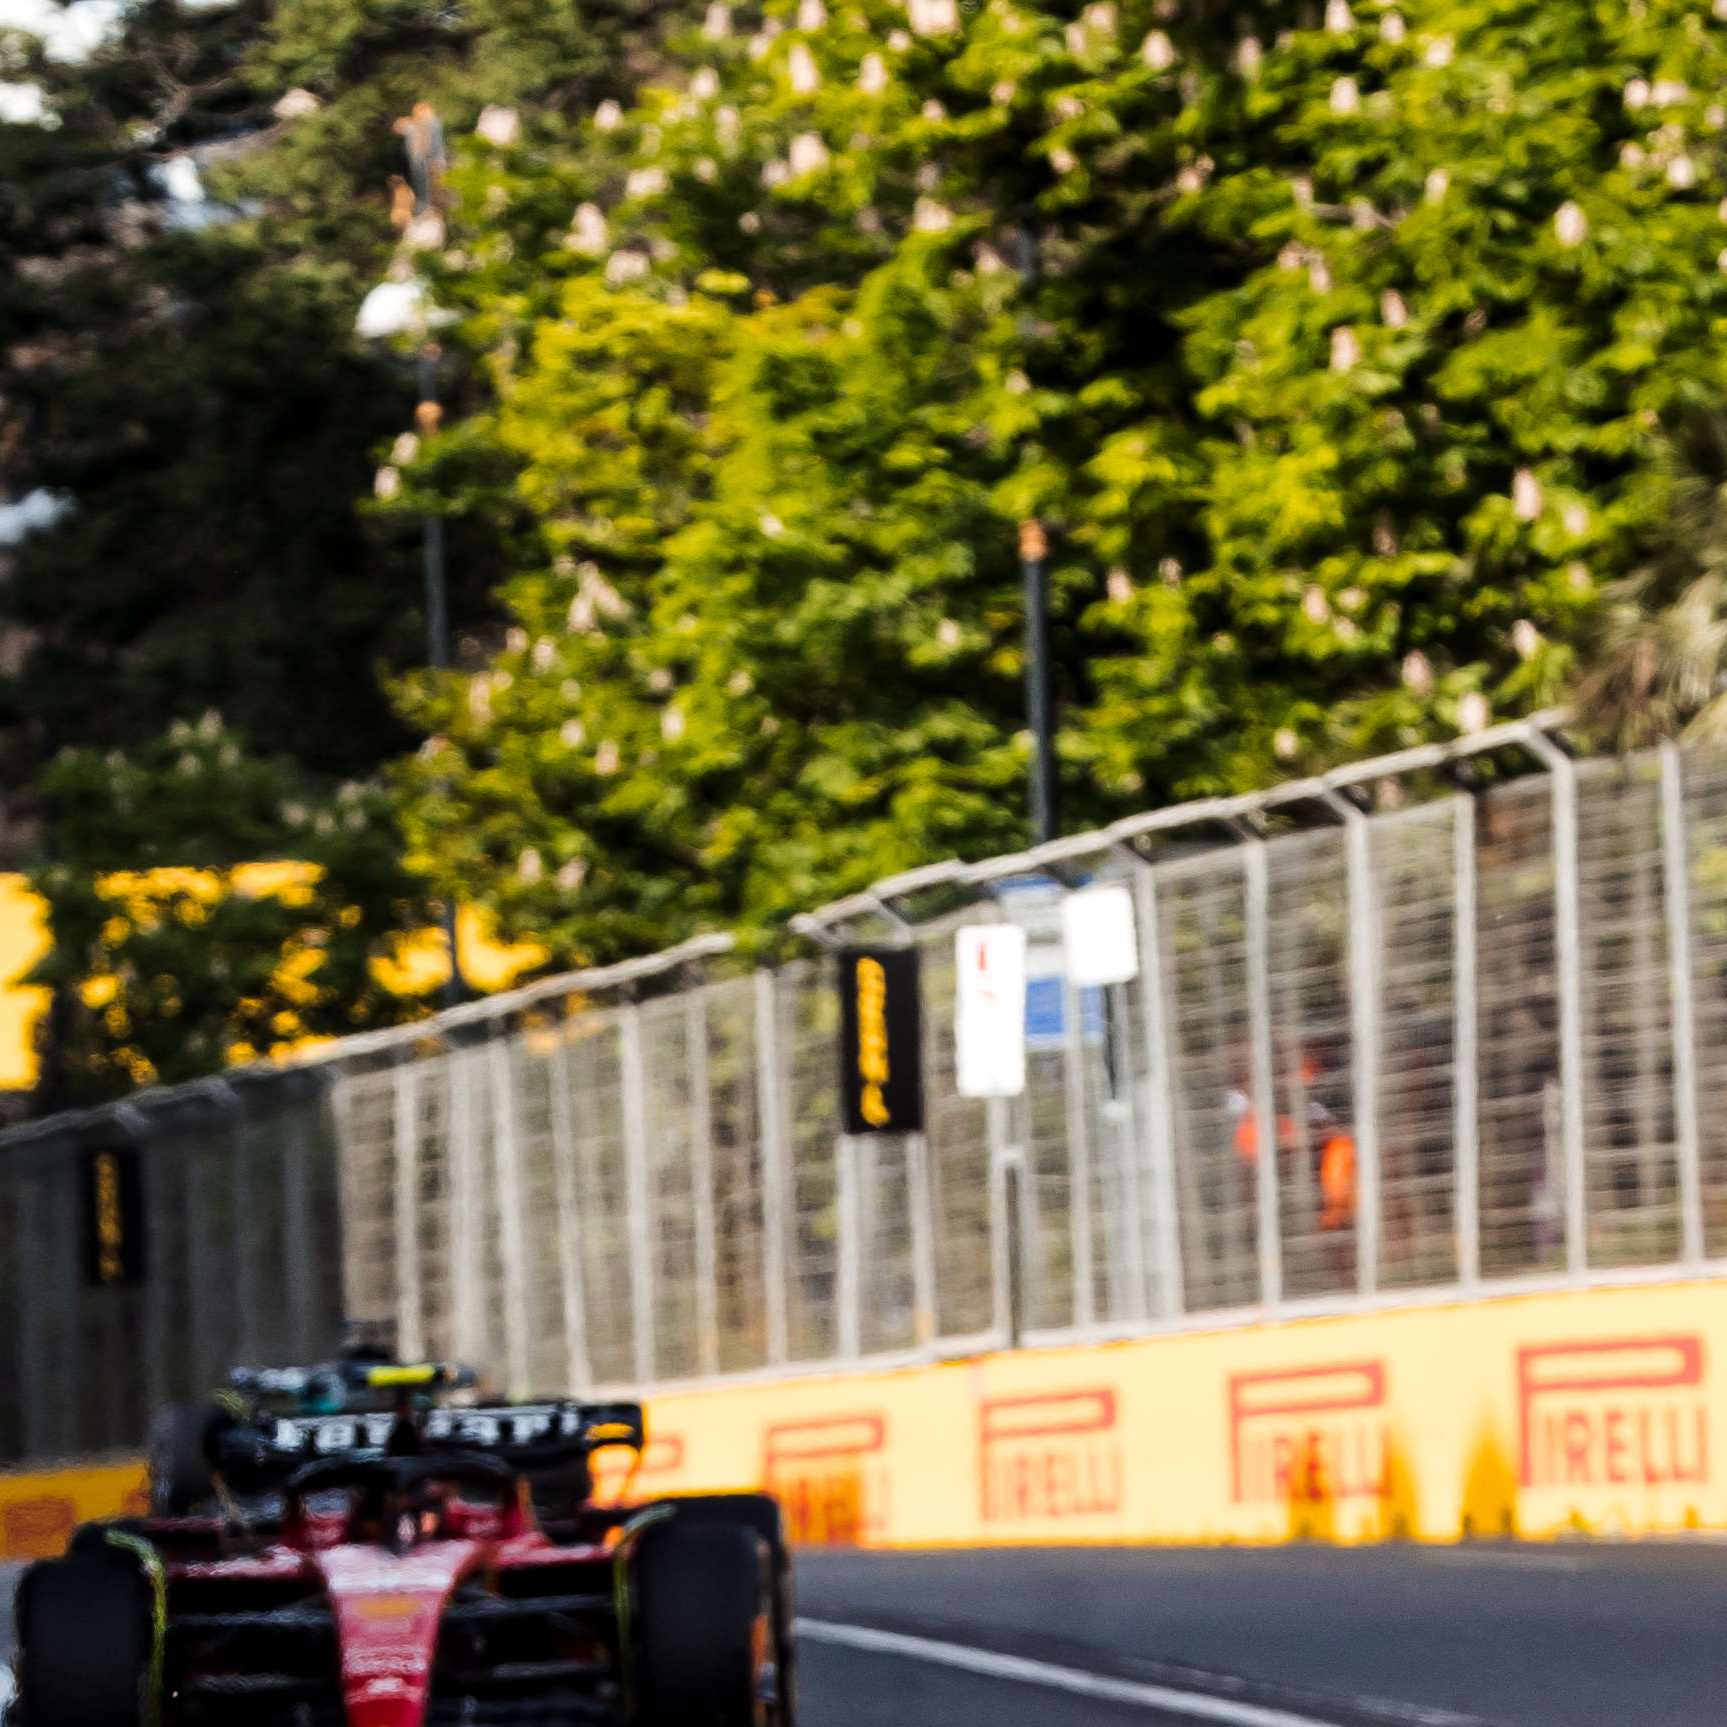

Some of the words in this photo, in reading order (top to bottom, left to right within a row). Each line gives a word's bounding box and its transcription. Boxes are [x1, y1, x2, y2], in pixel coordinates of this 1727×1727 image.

[979, 1388, 1121, 1522] PIRELLI
[1230, 1360, 1392, 1504] PIRELLI
[1518, 1336, 1709, 1487] PIRELLI
